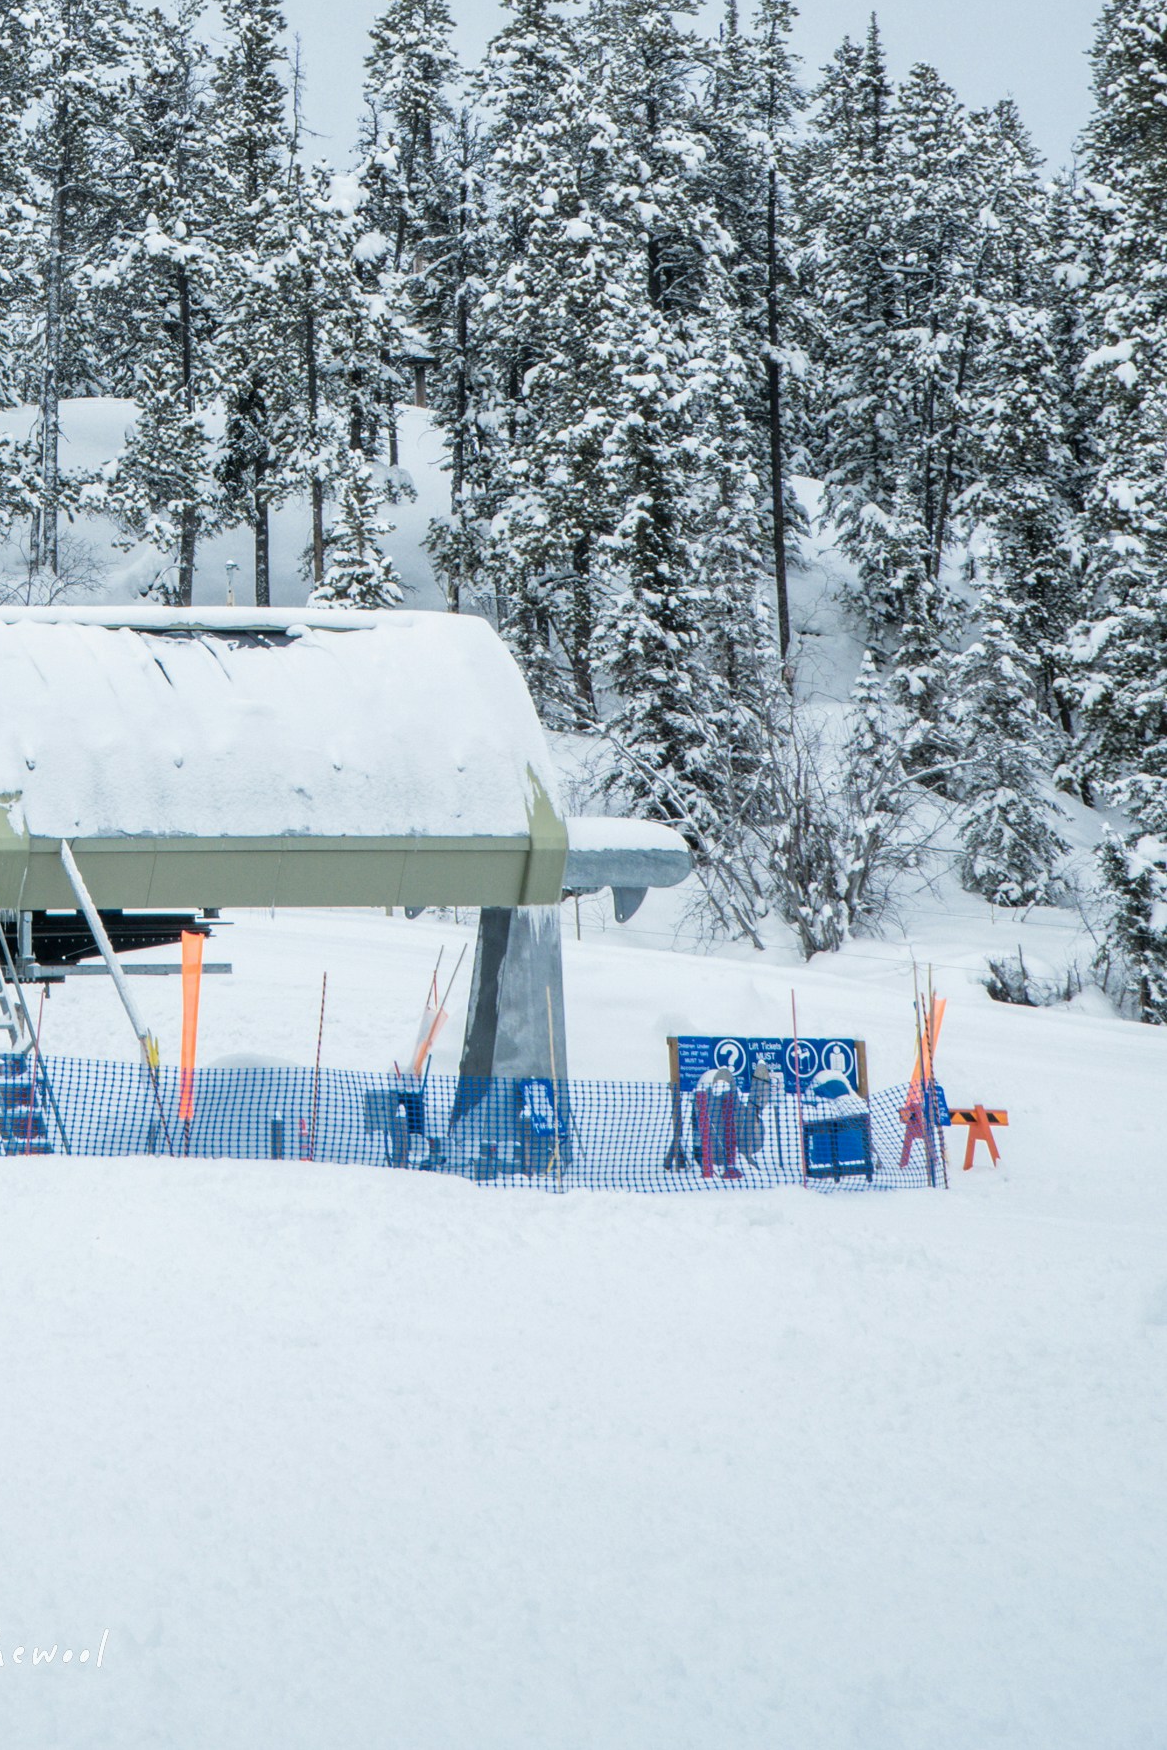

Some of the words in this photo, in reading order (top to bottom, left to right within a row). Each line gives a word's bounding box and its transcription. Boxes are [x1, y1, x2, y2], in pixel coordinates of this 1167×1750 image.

[748, 1042, 759, 1051] Lift
[761, 1042, 782, 1051] Tickets
[755, 1052, 775, 1061] MUST
